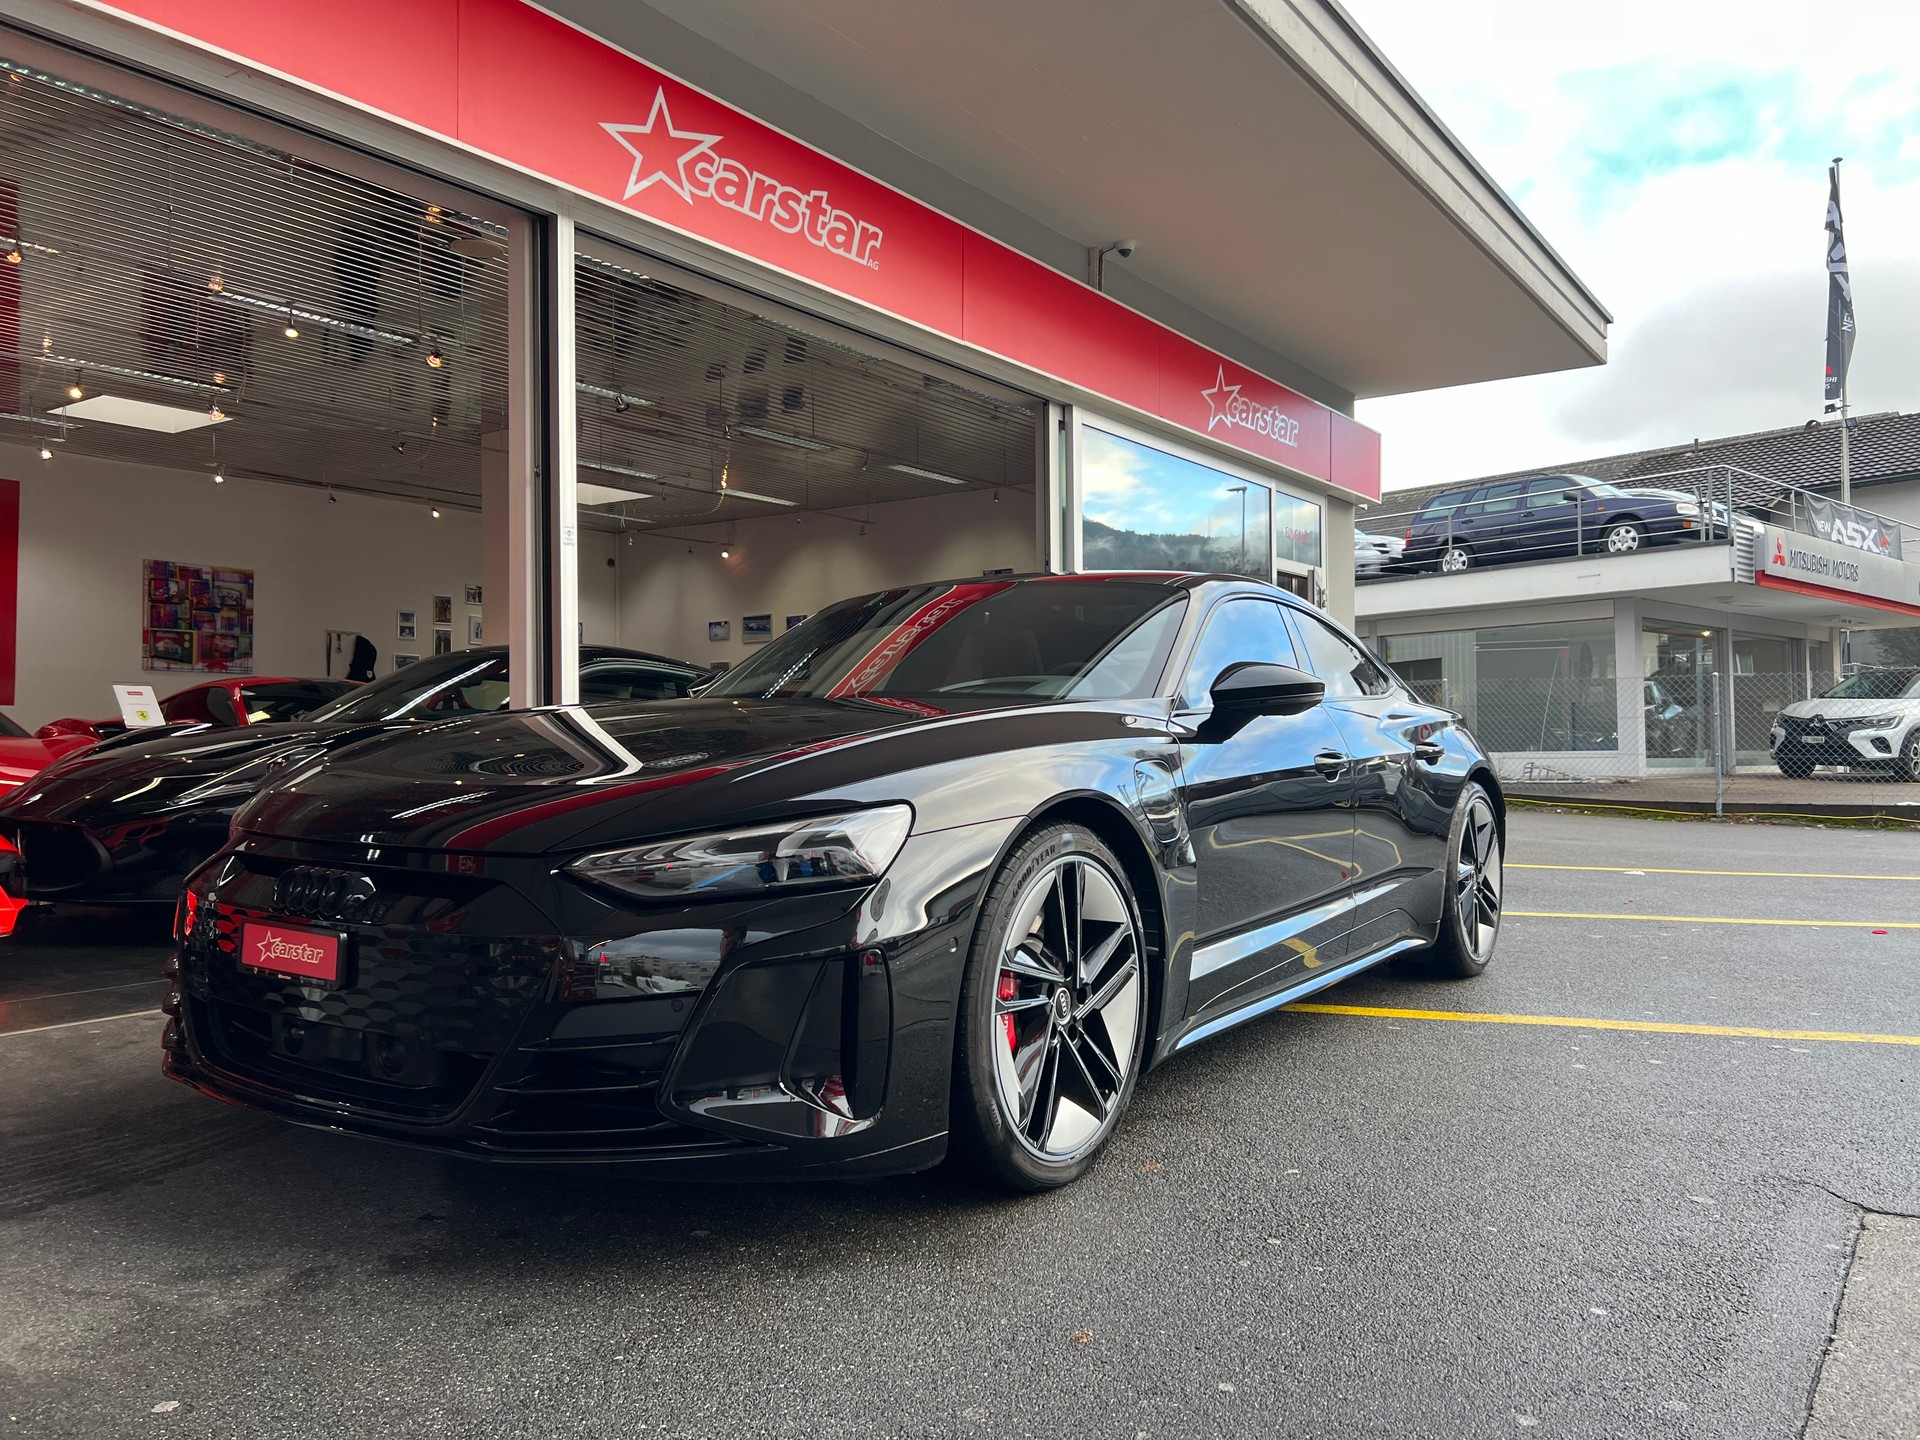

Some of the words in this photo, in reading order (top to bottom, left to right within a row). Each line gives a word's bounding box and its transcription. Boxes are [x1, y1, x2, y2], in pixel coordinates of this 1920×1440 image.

[683, 147, 883, 265] carstar
[867, 259, 880, 270] AG
[1227, 394, 1299, 446] carstar
[1816, 519, 1831, 533] NEW
[1831, 517, 1880, 553] ASX
[1788, 549, 1830, 575] MITSUBISHI
[1832, 559, 1859, 582] MOTORS
[272, 942, 324, 963] carstar
